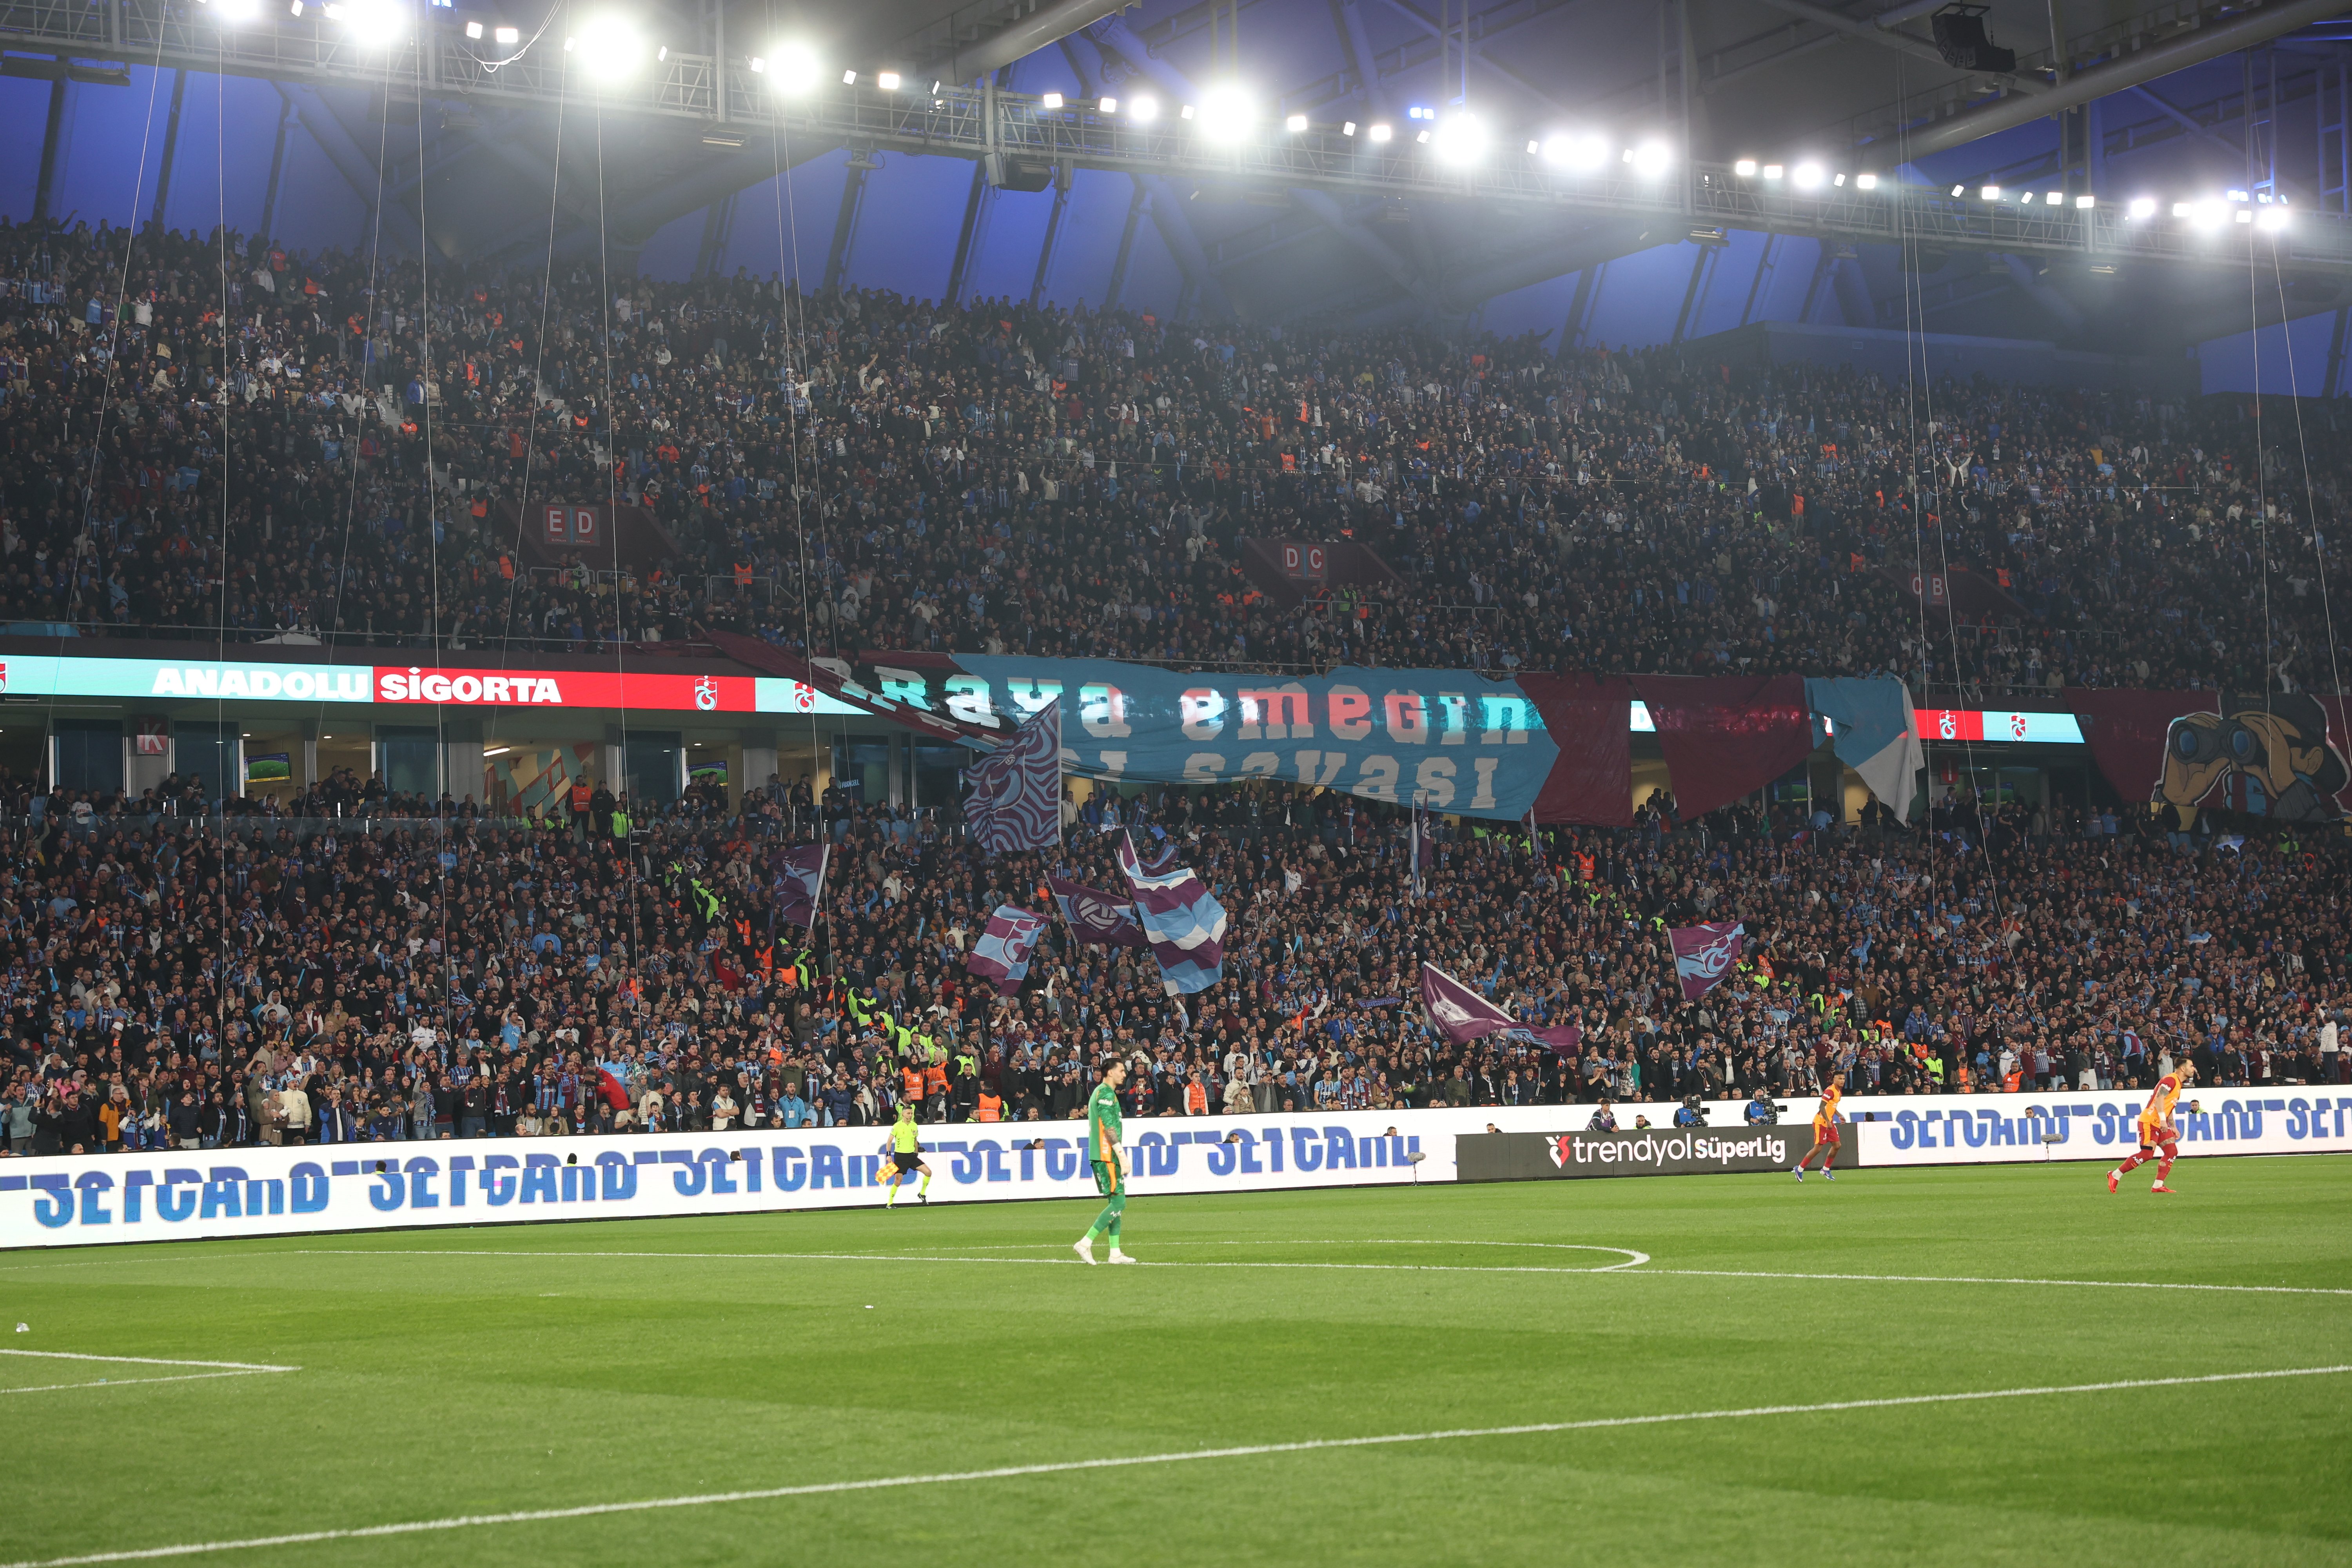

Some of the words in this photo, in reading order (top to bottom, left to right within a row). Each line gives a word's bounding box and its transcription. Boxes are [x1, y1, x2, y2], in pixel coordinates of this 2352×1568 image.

[549, 510, 563, 532] E
[578, 512, 593, 534] D
[1286, 548, 1298, 567] D
[1310, 549, 1322, 569] C
[1912, 577, 1922, 595] C
[1933, 577, 1943, 596] B
[151, 668, 368, 700] ANADOLU
[379, 666, 562, 704] SİGORTA
[144, 722, 163, 751] K
[1572, 1133, 1691, 1167] trendyol
